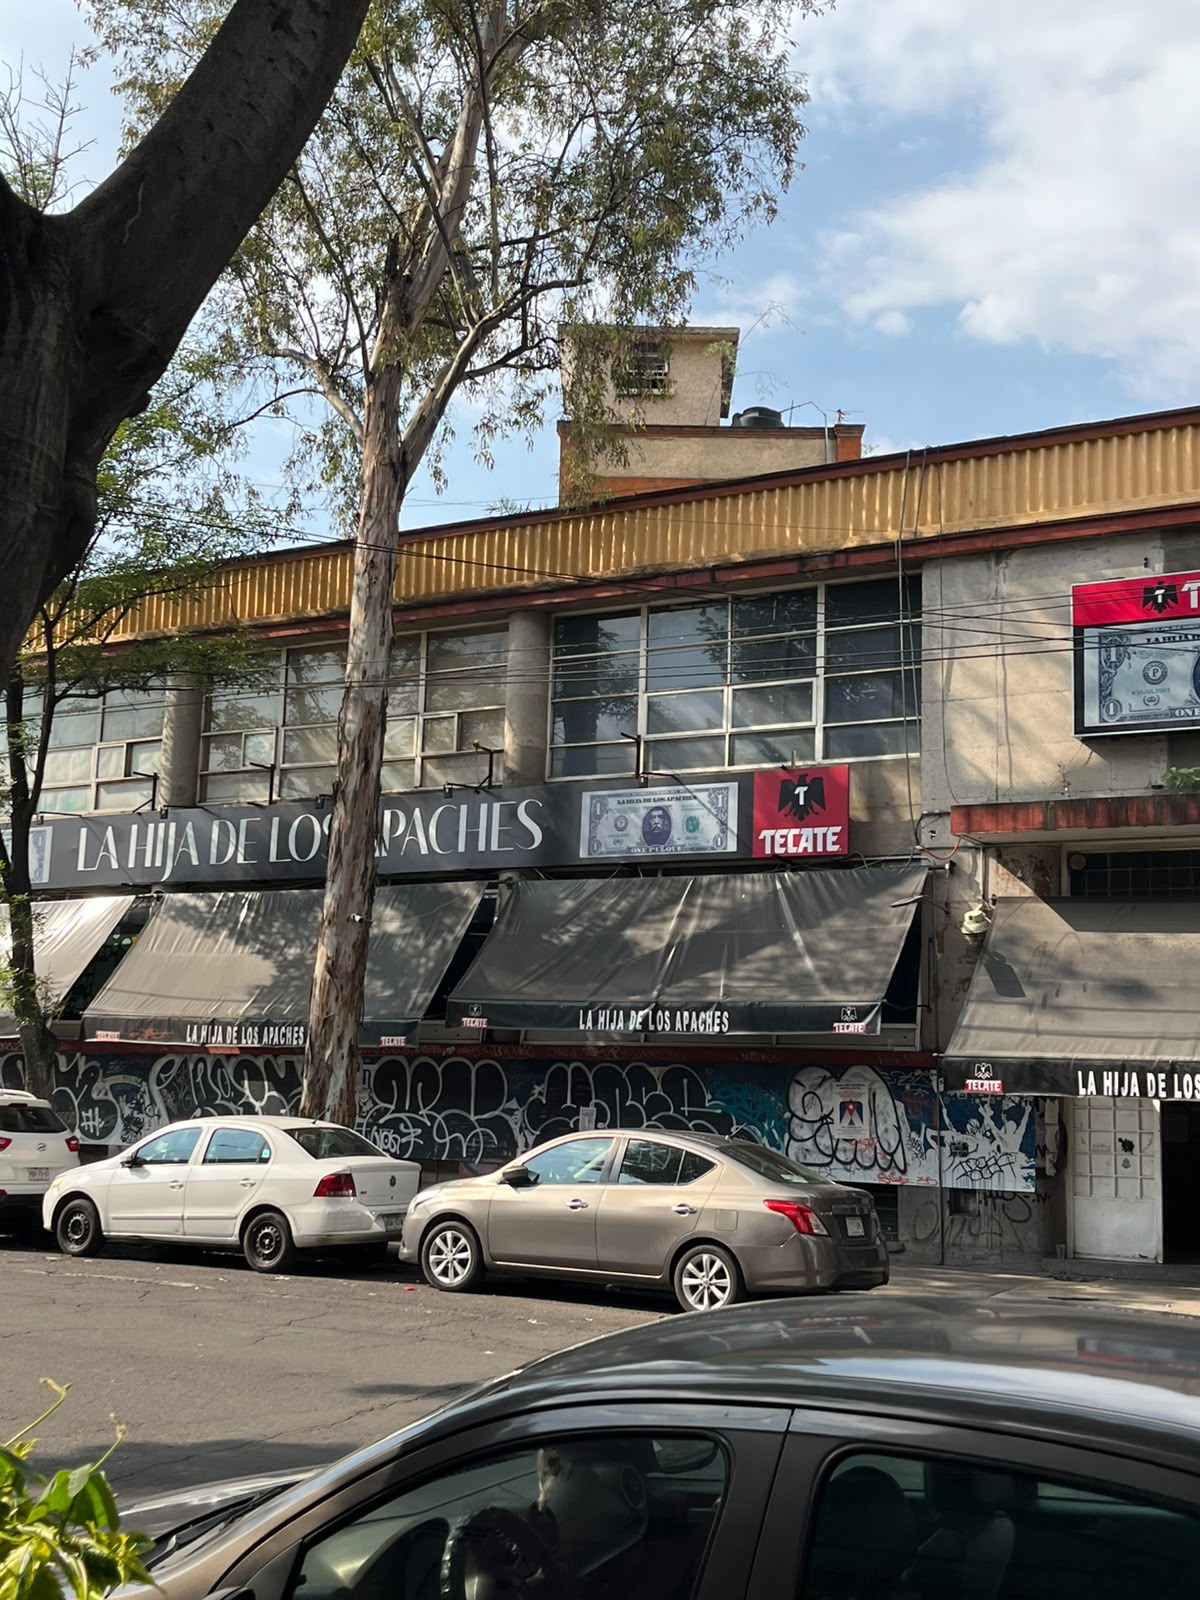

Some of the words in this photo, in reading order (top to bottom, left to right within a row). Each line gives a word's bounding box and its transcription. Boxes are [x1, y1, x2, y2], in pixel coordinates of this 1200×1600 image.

[1152, 668, 1159, 678] P
[794, 786, 808, 805] T
[77, 825, 119, 872] LA
[127, 821, 200, 883] HIJA
[209, 817, 261, 865] DE
[374, 799, 543, 858] PACHES
[758, 826, 842, 854] TECATE
[461, 1017, 488, 1028] TECATE
[579, 1010, 593, 1030] LA
[598, 1010, 624, 1030] HIJA
[629, 1010, 643, 1030] DE
[649, 1010, 671, 1031] LOS
[675, 1011, 729, 1032] APACHES
[833, 1022, 865, 1033] TECATE
[186, 1024, 198, 1043] LA
[200, 1025, 223, 1044] HIJA
[226, 1026, 238, 1044] DE
[241, 1026, 259, 1045] LOS
[262, 1026, 304, 1045] APACHES
[965, 1079, 1002, 1092] TECATE
[1077, 1070, 1097, 1096] LA
[1103, 1071, 1140, 1097] HIJA
[1146, 1072, 1167, 1098] DE
